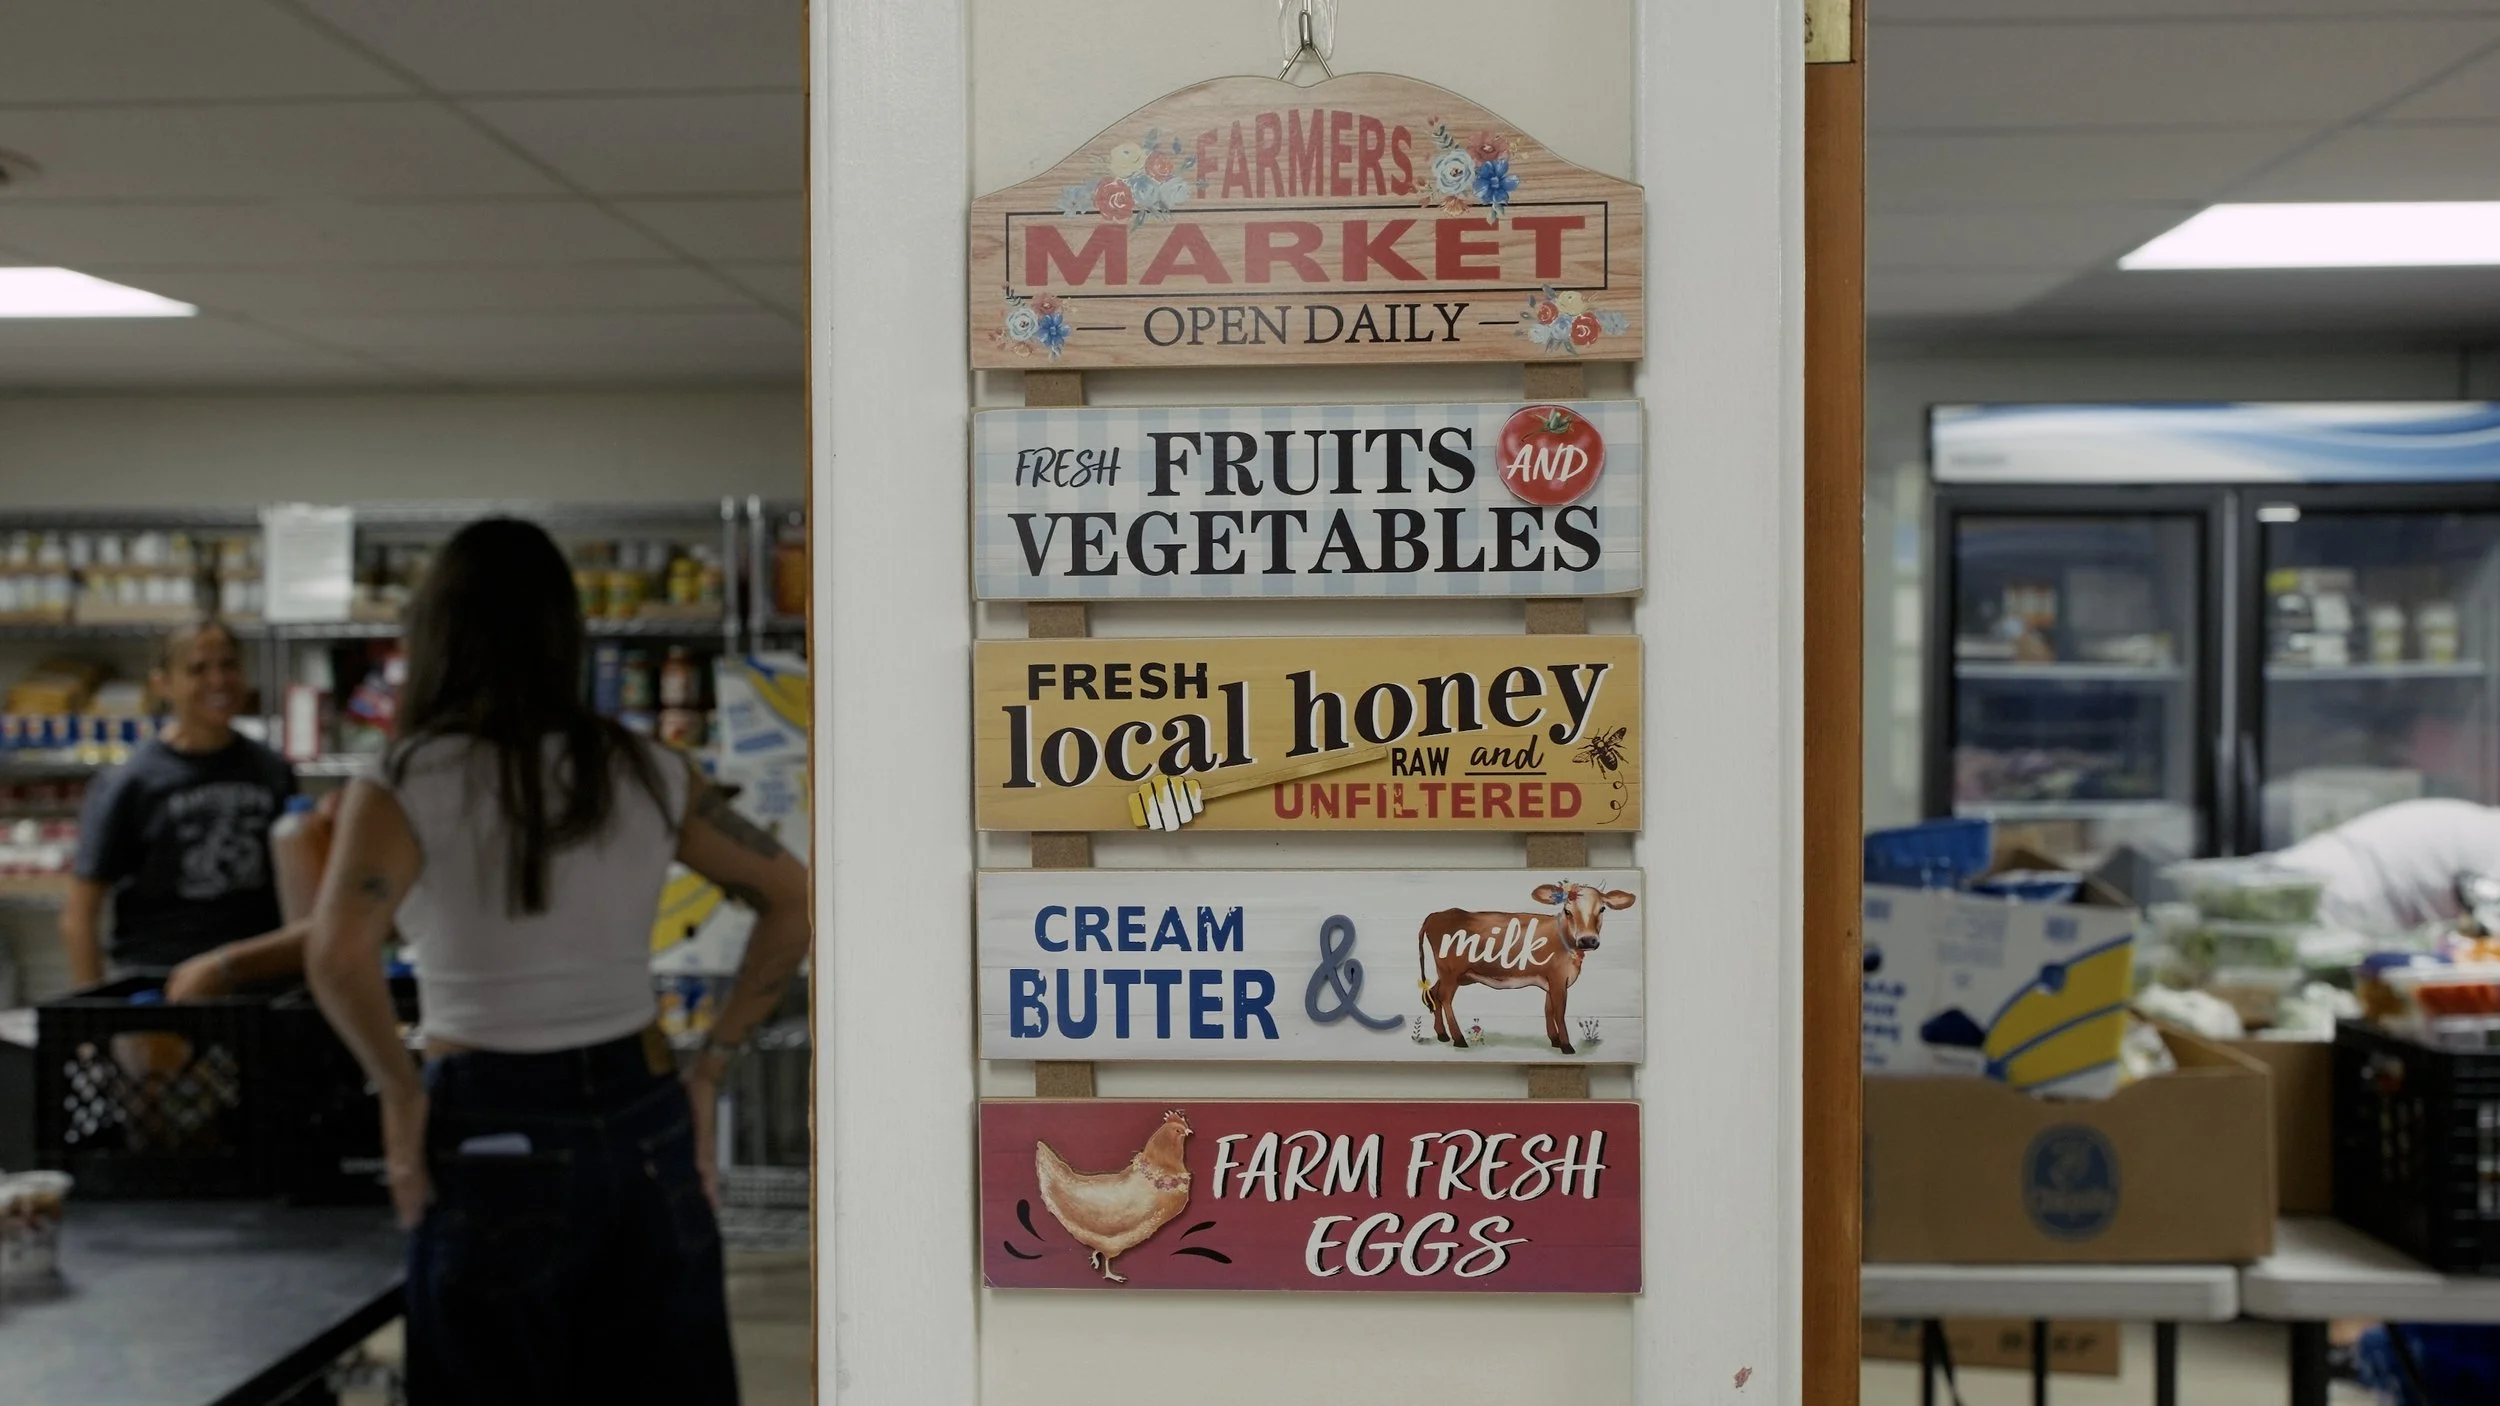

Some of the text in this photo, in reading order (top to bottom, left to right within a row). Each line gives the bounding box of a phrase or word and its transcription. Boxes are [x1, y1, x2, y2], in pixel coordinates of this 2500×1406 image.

[1194, 109, 1414, 199] FARMERS
[1025, 216, 1586, 286] MARKET
[1144, 303, 1469, 346] OPEN DAILY
[1015, 427, 1588, 497] FRESH FRUITS AND
[1008, 505, 1601, 577] VEGETABLES
[1027, 662, 1209, 701] FRESH
[1001, 663, 1611, 790] local honey
[1391, 735, 1545, 777] RAW and
[1273, 783, 1582, 819] UNFILTERED
[1034, 905, 1244, 952] CREAM
[1438, 917, 1555, 970] milk
[1009, 968, 1280, 1040] BUTTER
[1304, 914, 1405, 1030] &
[1212, 1130, 1606, 1202] FARM FRESH
[1304, 1212, 1531, 1277] EGGS
